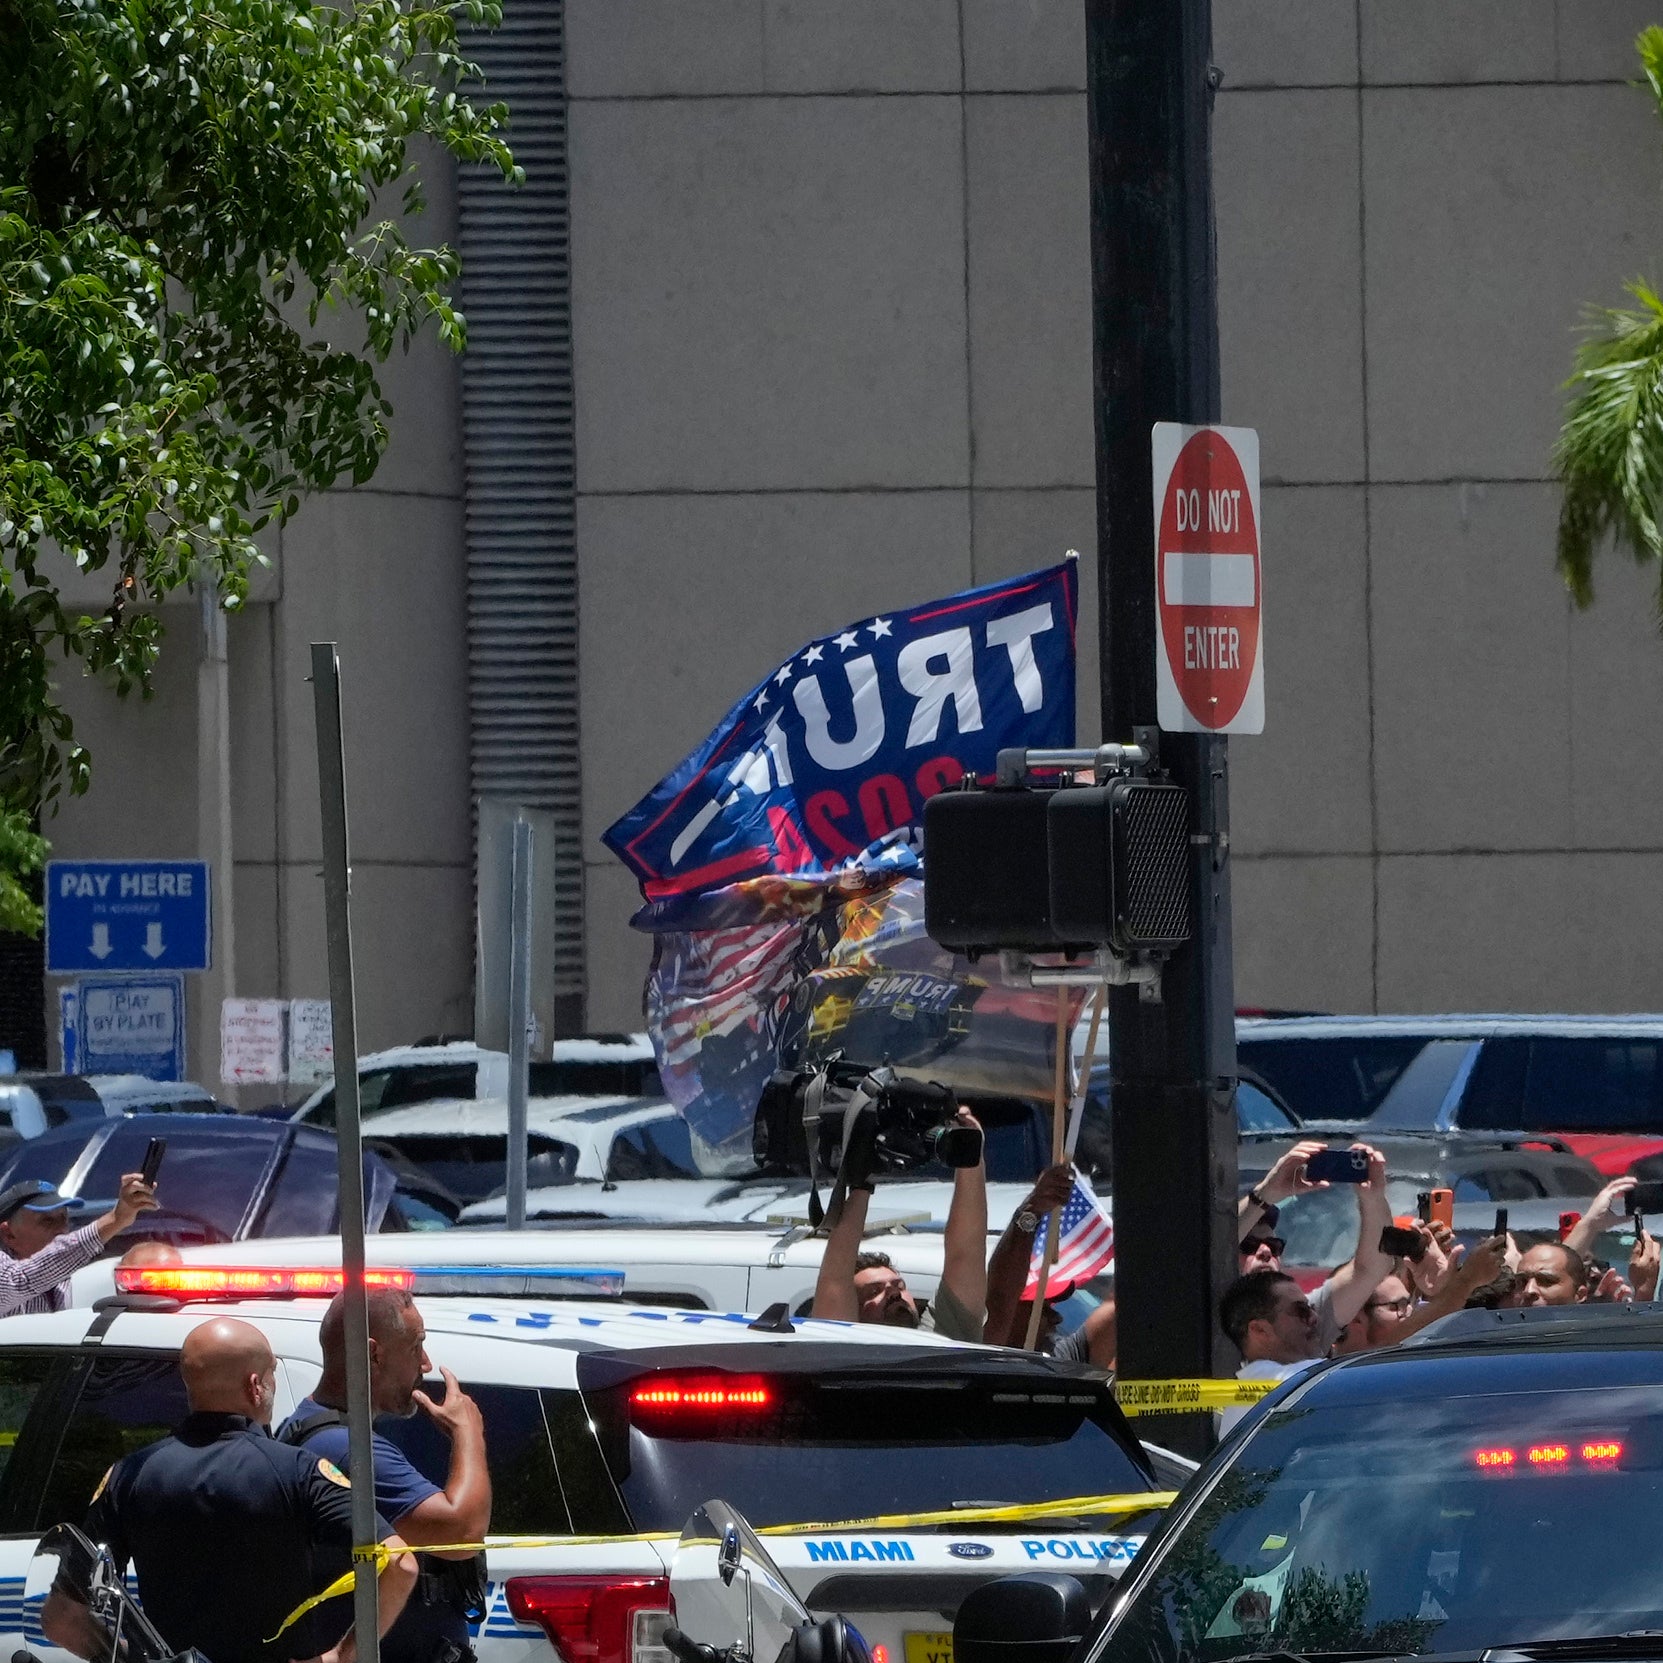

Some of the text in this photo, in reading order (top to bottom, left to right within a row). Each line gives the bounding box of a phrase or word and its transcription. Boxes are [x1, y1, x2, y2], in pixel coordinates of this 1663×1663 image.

[1176, 489, 1240, 533] DO NOT
[1184, 626, 1240, 669] ENTER
[60, 872, 193, 897] PAY HERE
[117, 1013, 166, 1031] PLATE
[804, 1540, 1140, 1562] MIAMI Ford POLICE
